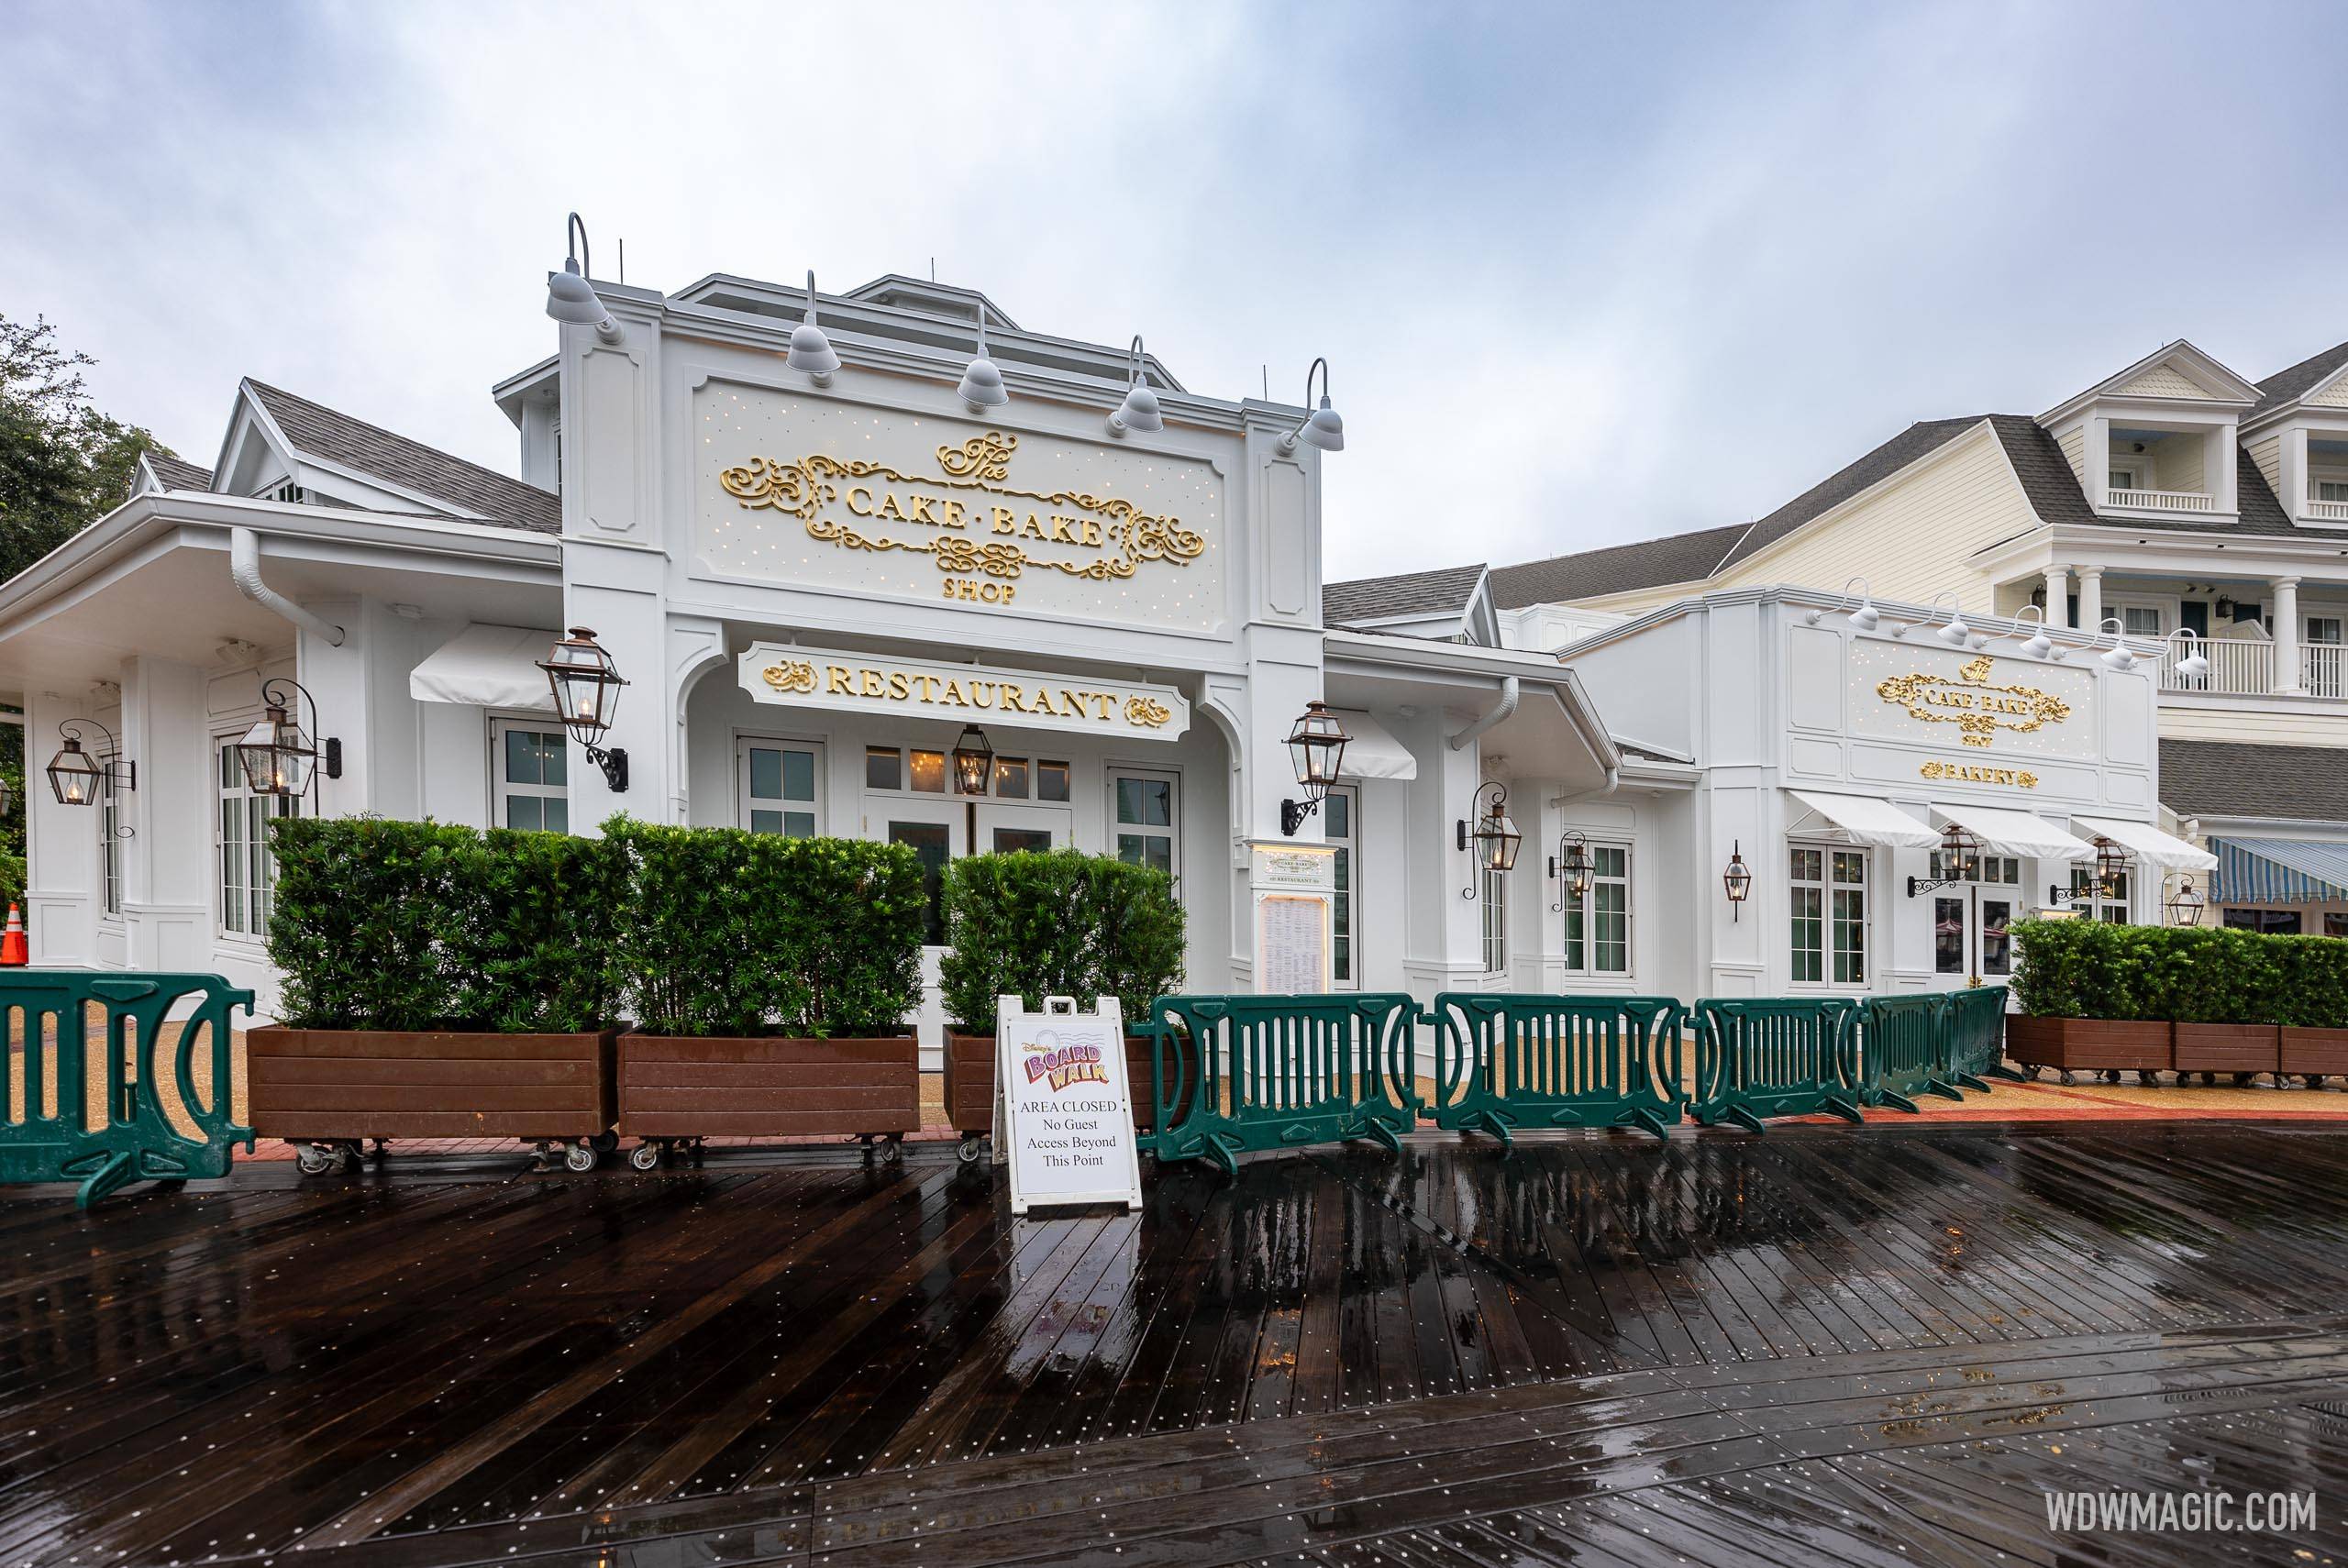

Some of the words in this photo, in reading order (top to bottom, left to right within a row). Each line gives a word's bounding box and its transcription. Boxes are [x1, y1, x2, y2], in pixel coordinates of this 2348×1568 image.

[936, 431, 1018, 480] The
[846, 487, 968, 529] CAKE
[991, 505, 1104, 548] BAKE
[943, 578, 1015, 604] SHOP
[1959, 656, 1994, 682] The
[826, 665, 1117, 720] RESTAURANT
[1924, 690, 1973, 709] CAKE
[1981, 696, 2029, 715] BAKE
[1944, 763, 2016, 785] BAKERY
[1024, 1045, 1102, 1084] BOARD
[1047, 1063, 1109, 1093] WALK
[1020, 1101, 1059, 1112] AREA
[1062, 1100, 1117, 1112] CLOSED
[1043, 1119, 1061, 1130] No
[1064, 1119, 1098, 1130] Guest
[1027, 1137, 1069, 1149] Access
[1072, 1135, 1116, 1150] Beyond
[1043, 1154, 1069, 1167] This
[1073, 1154, 1103, 1166] Point
